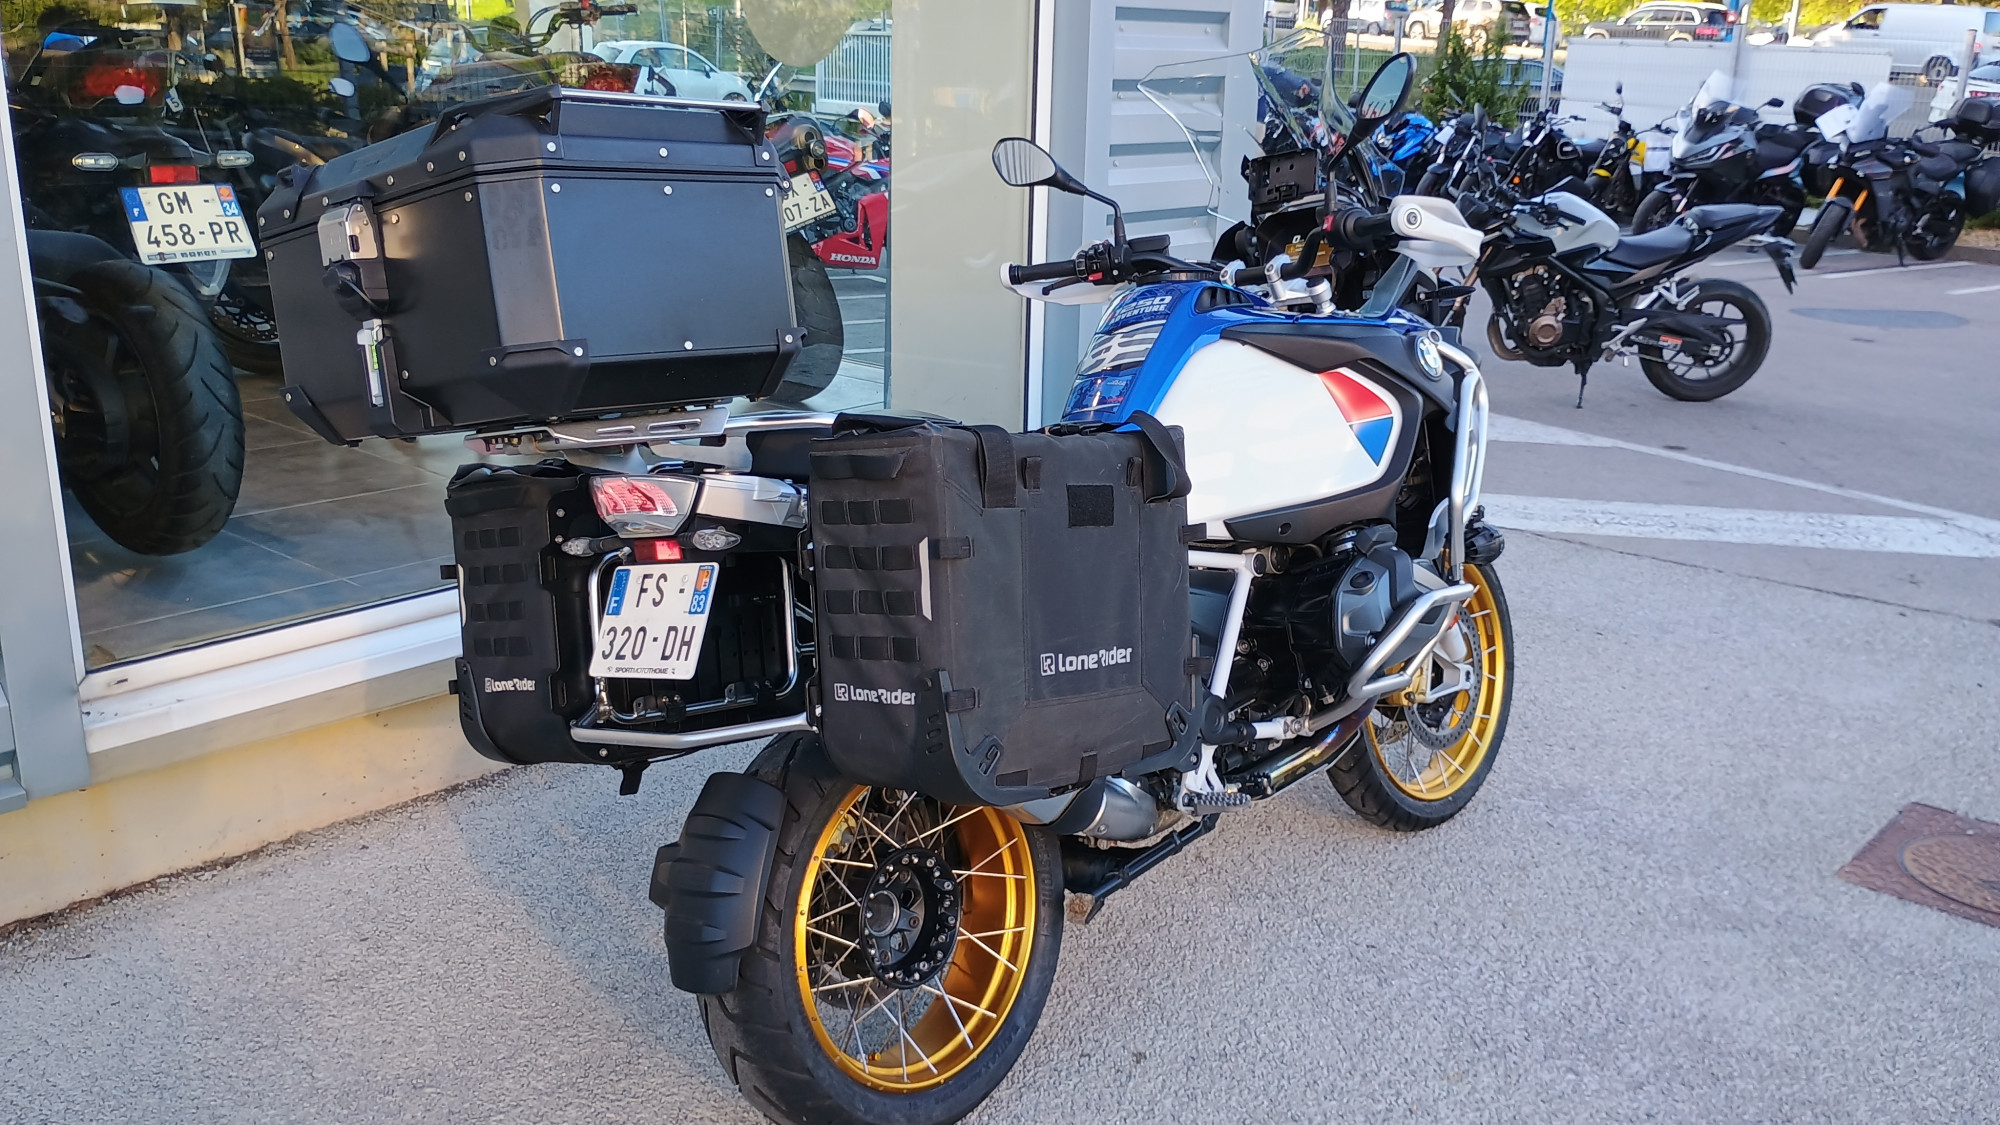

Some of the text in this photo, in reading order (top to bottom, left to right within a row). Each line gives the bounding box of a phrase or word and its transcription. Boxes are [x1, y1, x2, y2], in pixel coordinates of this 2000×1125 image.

[133, 207, 140, 217] F
[157, 191, 193, 215] GM
[222, 202, 239, 216] 34
[783, 194, 832, 224] 07-ZA
[147, 220, 244, 248] 458-PR
[830, 253, 877, 265] HONDA
[636, 573, 668, 608] FS
[608, 597, 620, 614] F
[690, 595, 706, 613] 83
[602, 626, 696, 661] 320-DH
